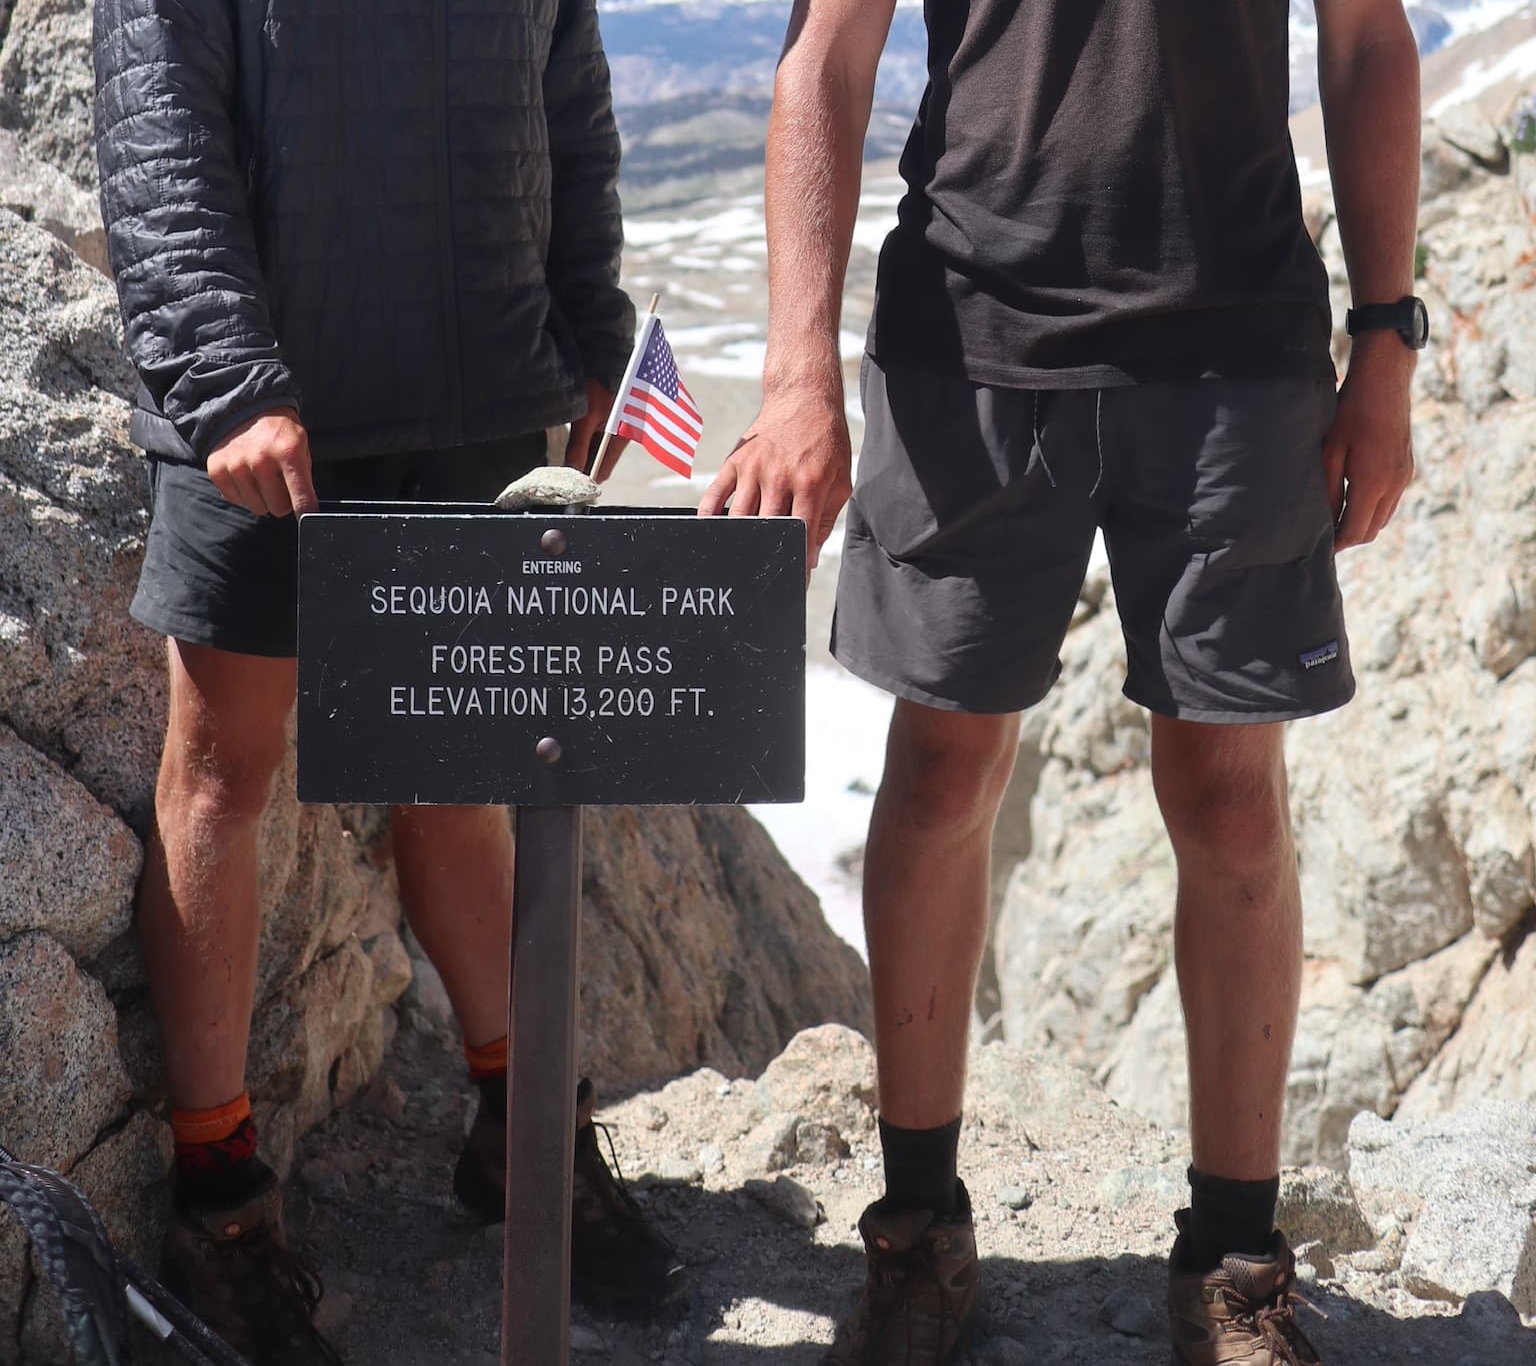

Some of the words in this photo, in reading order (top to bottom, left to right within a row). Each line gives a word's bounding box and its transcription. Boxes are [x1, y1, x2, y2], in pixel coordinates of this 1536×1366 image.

[521, 560, 583, 575] ENTERING
[370, 585, 493, 616] SEQUOIA
[506, 586, 647, 616] NATIONAL
[661, 586, 736, 616] PARK
[431, 645, 583, 675] FORESTER
[598, 646, 674, 675] PASS
[389, 686, 548, 716] ELEVATION
[563, 687, 655, 718] 13,200
[670, 687, 715, 716] FT.
